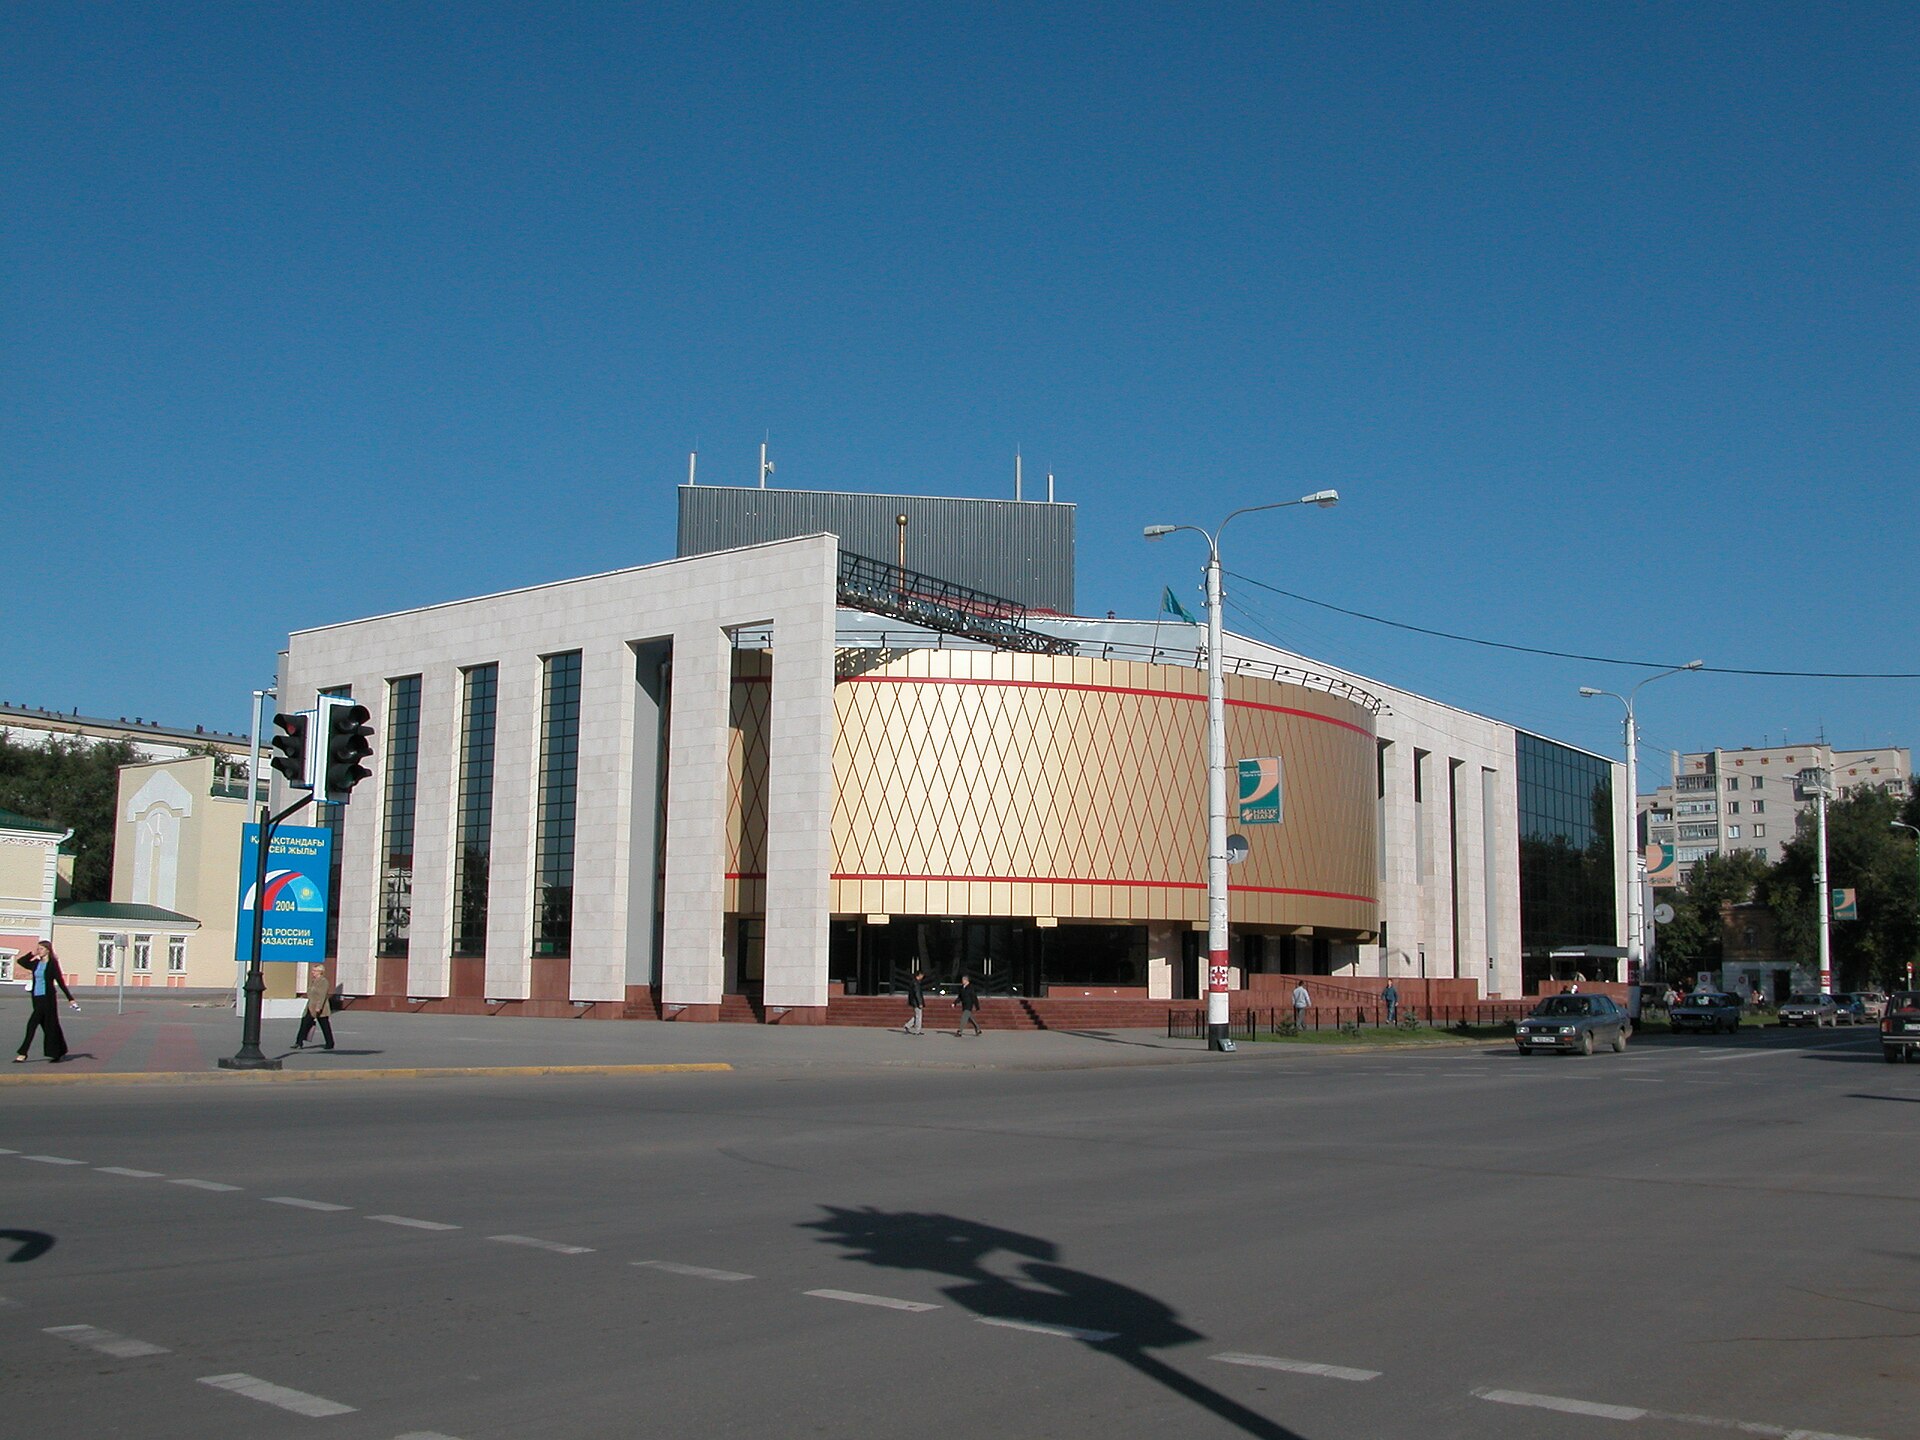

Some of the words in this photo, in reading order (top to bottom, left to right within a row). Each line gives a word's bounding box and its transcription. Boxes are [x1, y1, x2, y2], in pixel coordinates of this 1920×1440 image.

[251, 835, 325, 847] ҚҚСТАНДАҒЫ
[268, 845, 286, 854] СЕЙ
[287, 846, 317, 855] ЖЫЛЫ
[275, 900, 295, 911] 2004
[261, 927, 273, 936] ОД
[275, 928, 311, 937] РОССИИ
[261, 937, 314, 946] КАЗАХСТАНЕ
